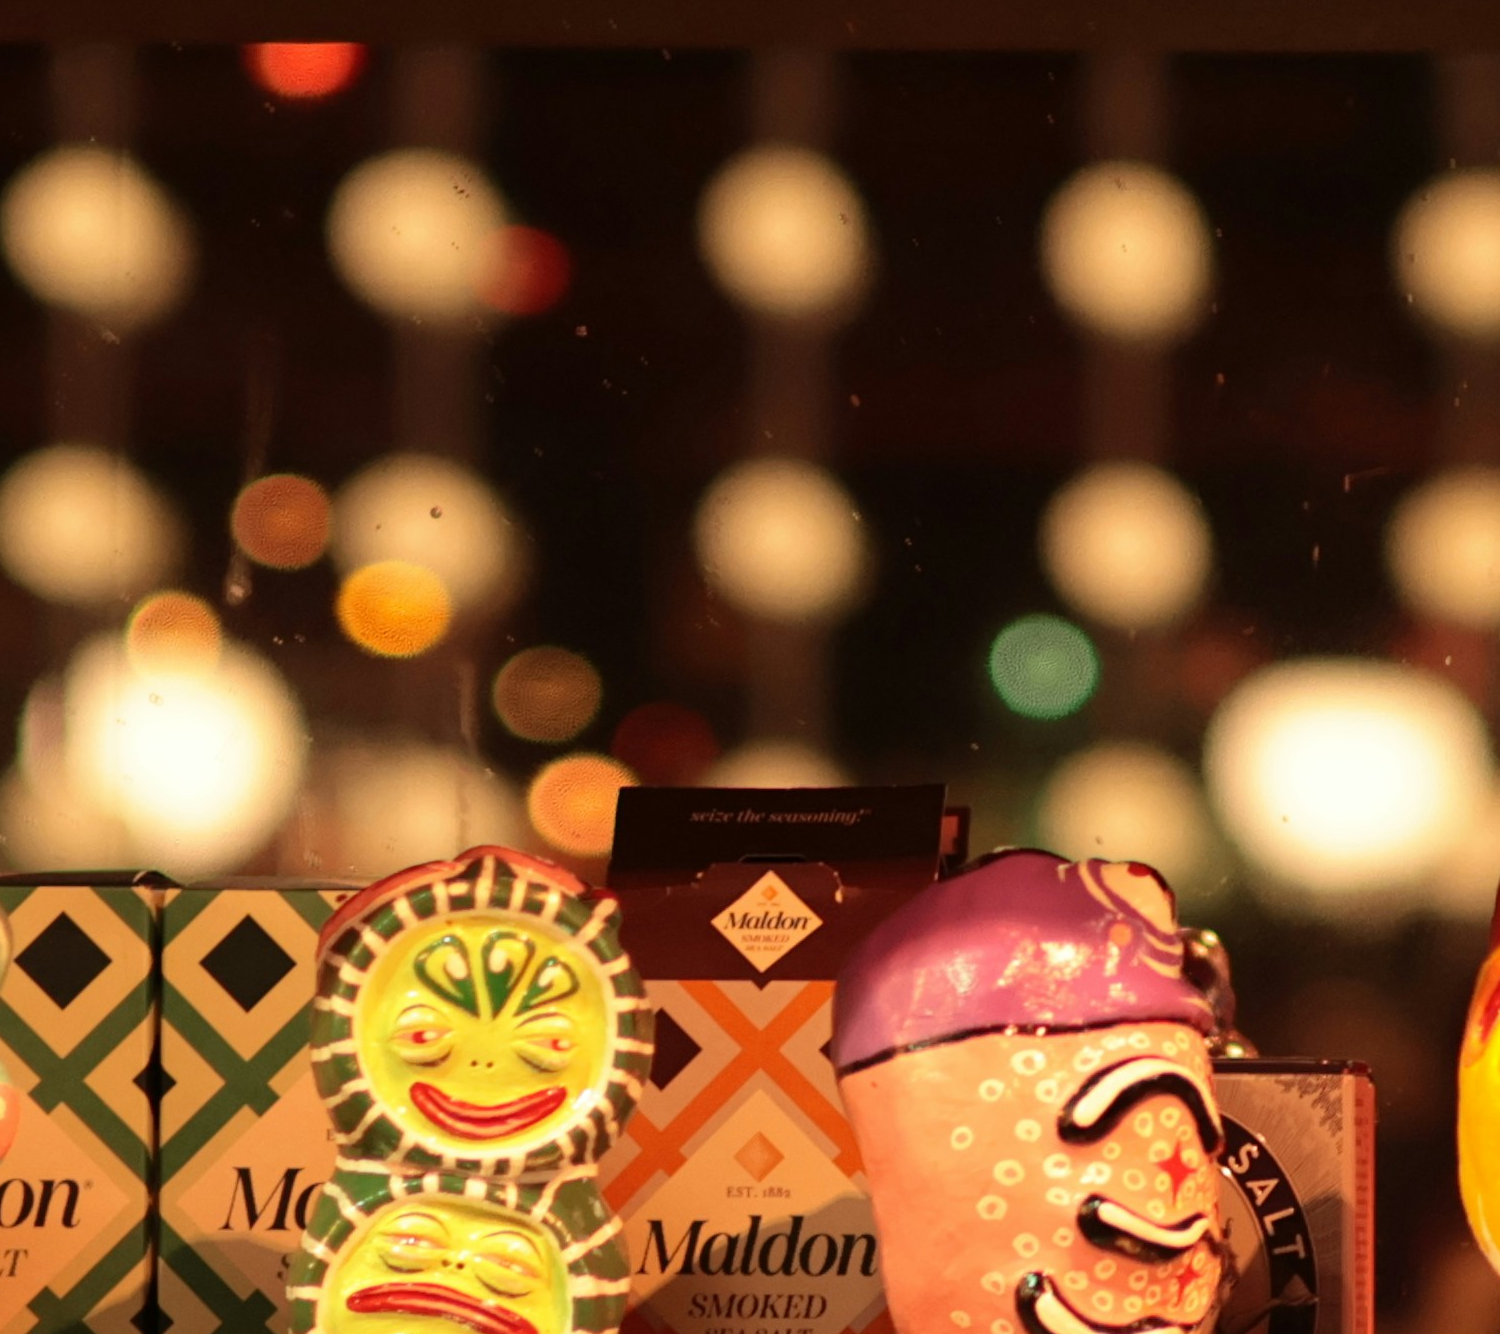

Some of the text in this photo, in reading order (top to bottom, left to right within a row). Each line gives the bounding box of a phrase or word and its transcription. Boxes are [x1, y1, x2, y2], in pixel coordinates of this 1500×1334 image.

[737, 808, 766, 824] the
[723, 911, 810, 932] Maldon
[726, 1185, 791, 1199] EST. 1882
[1228, 1141, 1308, 1261] SALT
[635, 1214, 878, 1278] Maldon
[688, 1293, 828, 1320] SMOKED
